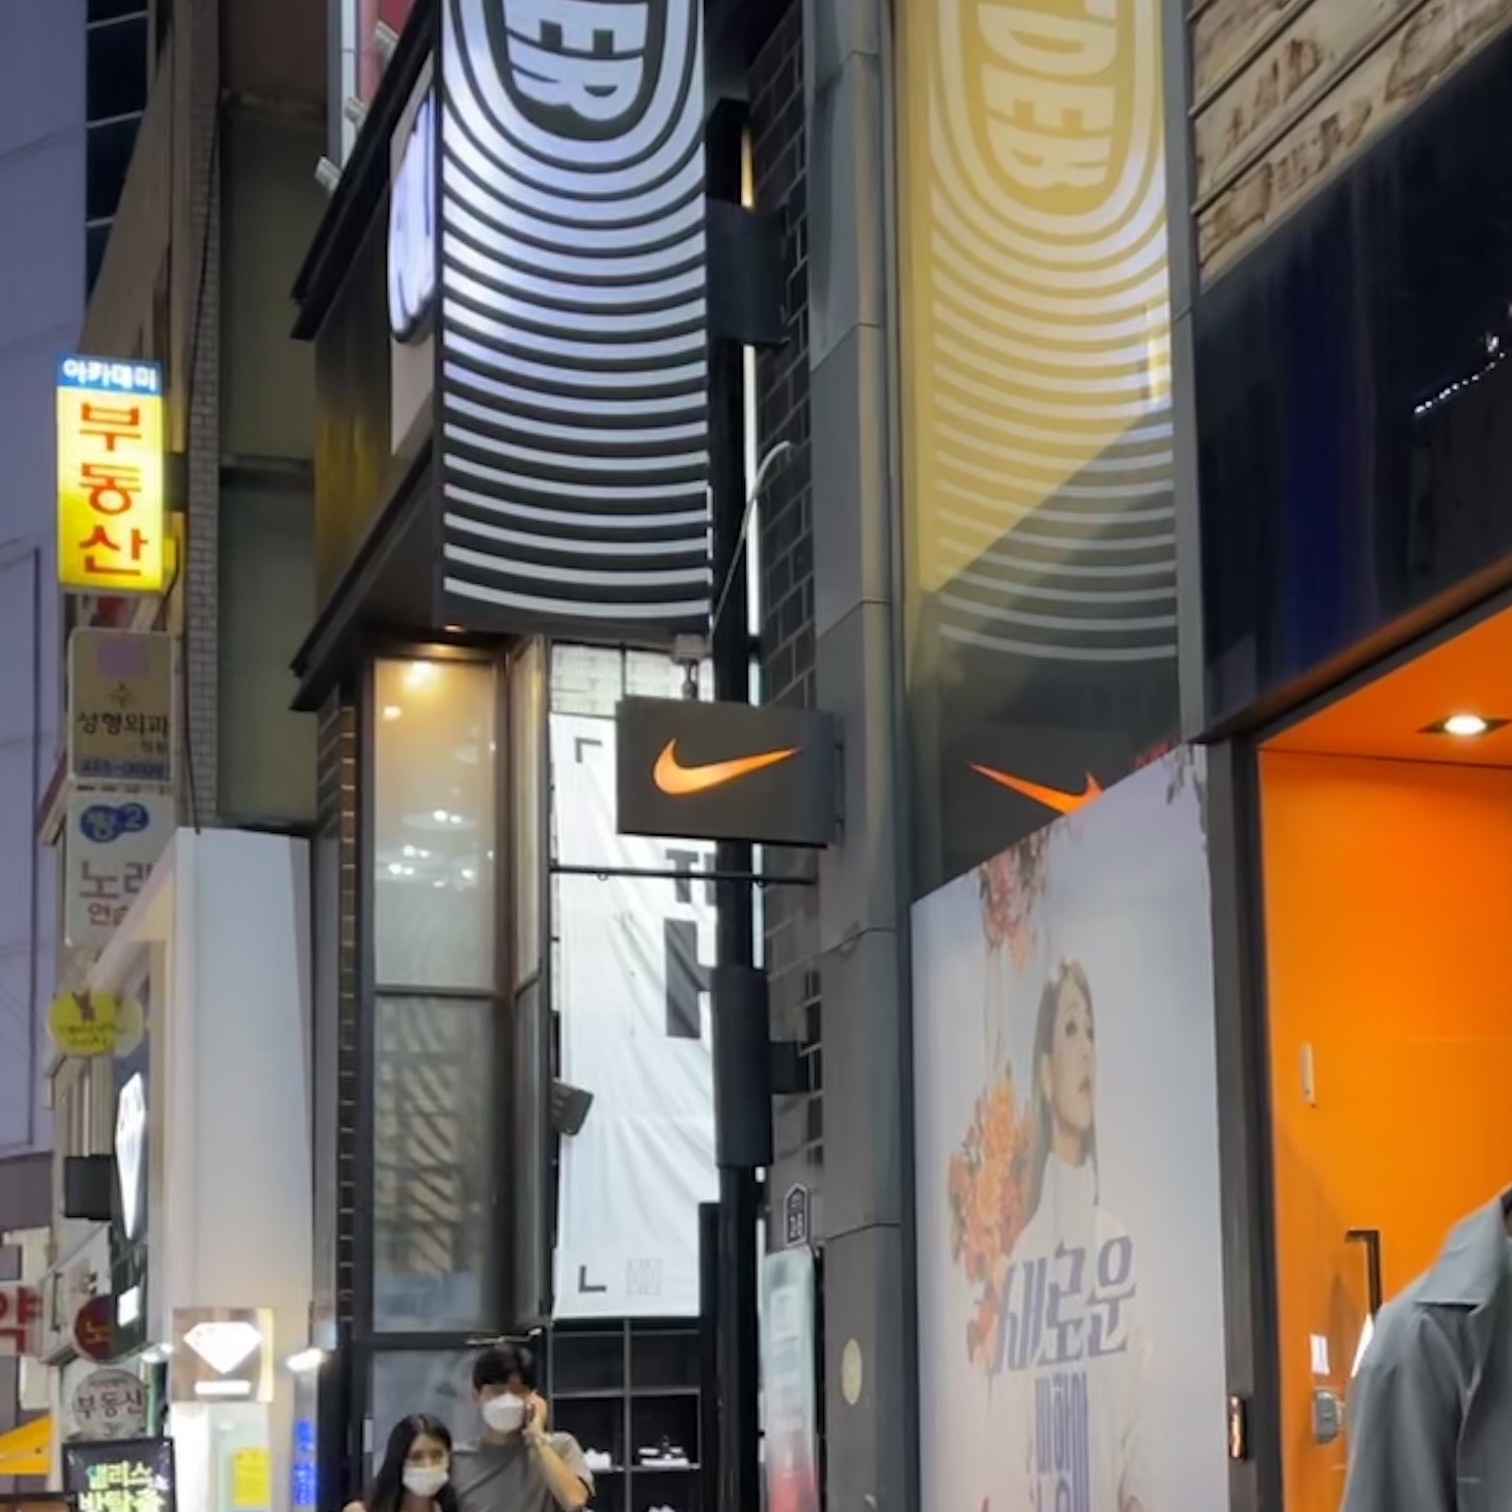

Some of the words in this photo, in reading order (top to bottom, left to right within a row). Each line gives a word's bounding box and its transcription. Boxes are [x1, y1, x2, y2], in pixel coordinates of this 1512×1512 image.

[78, 402, 149, 577] 부동산
[77, 711, 170, 738] 성형외과
[990, 1235, 1137, 1374] 새로운
[77, 1388, 145, 1419] 부동산
